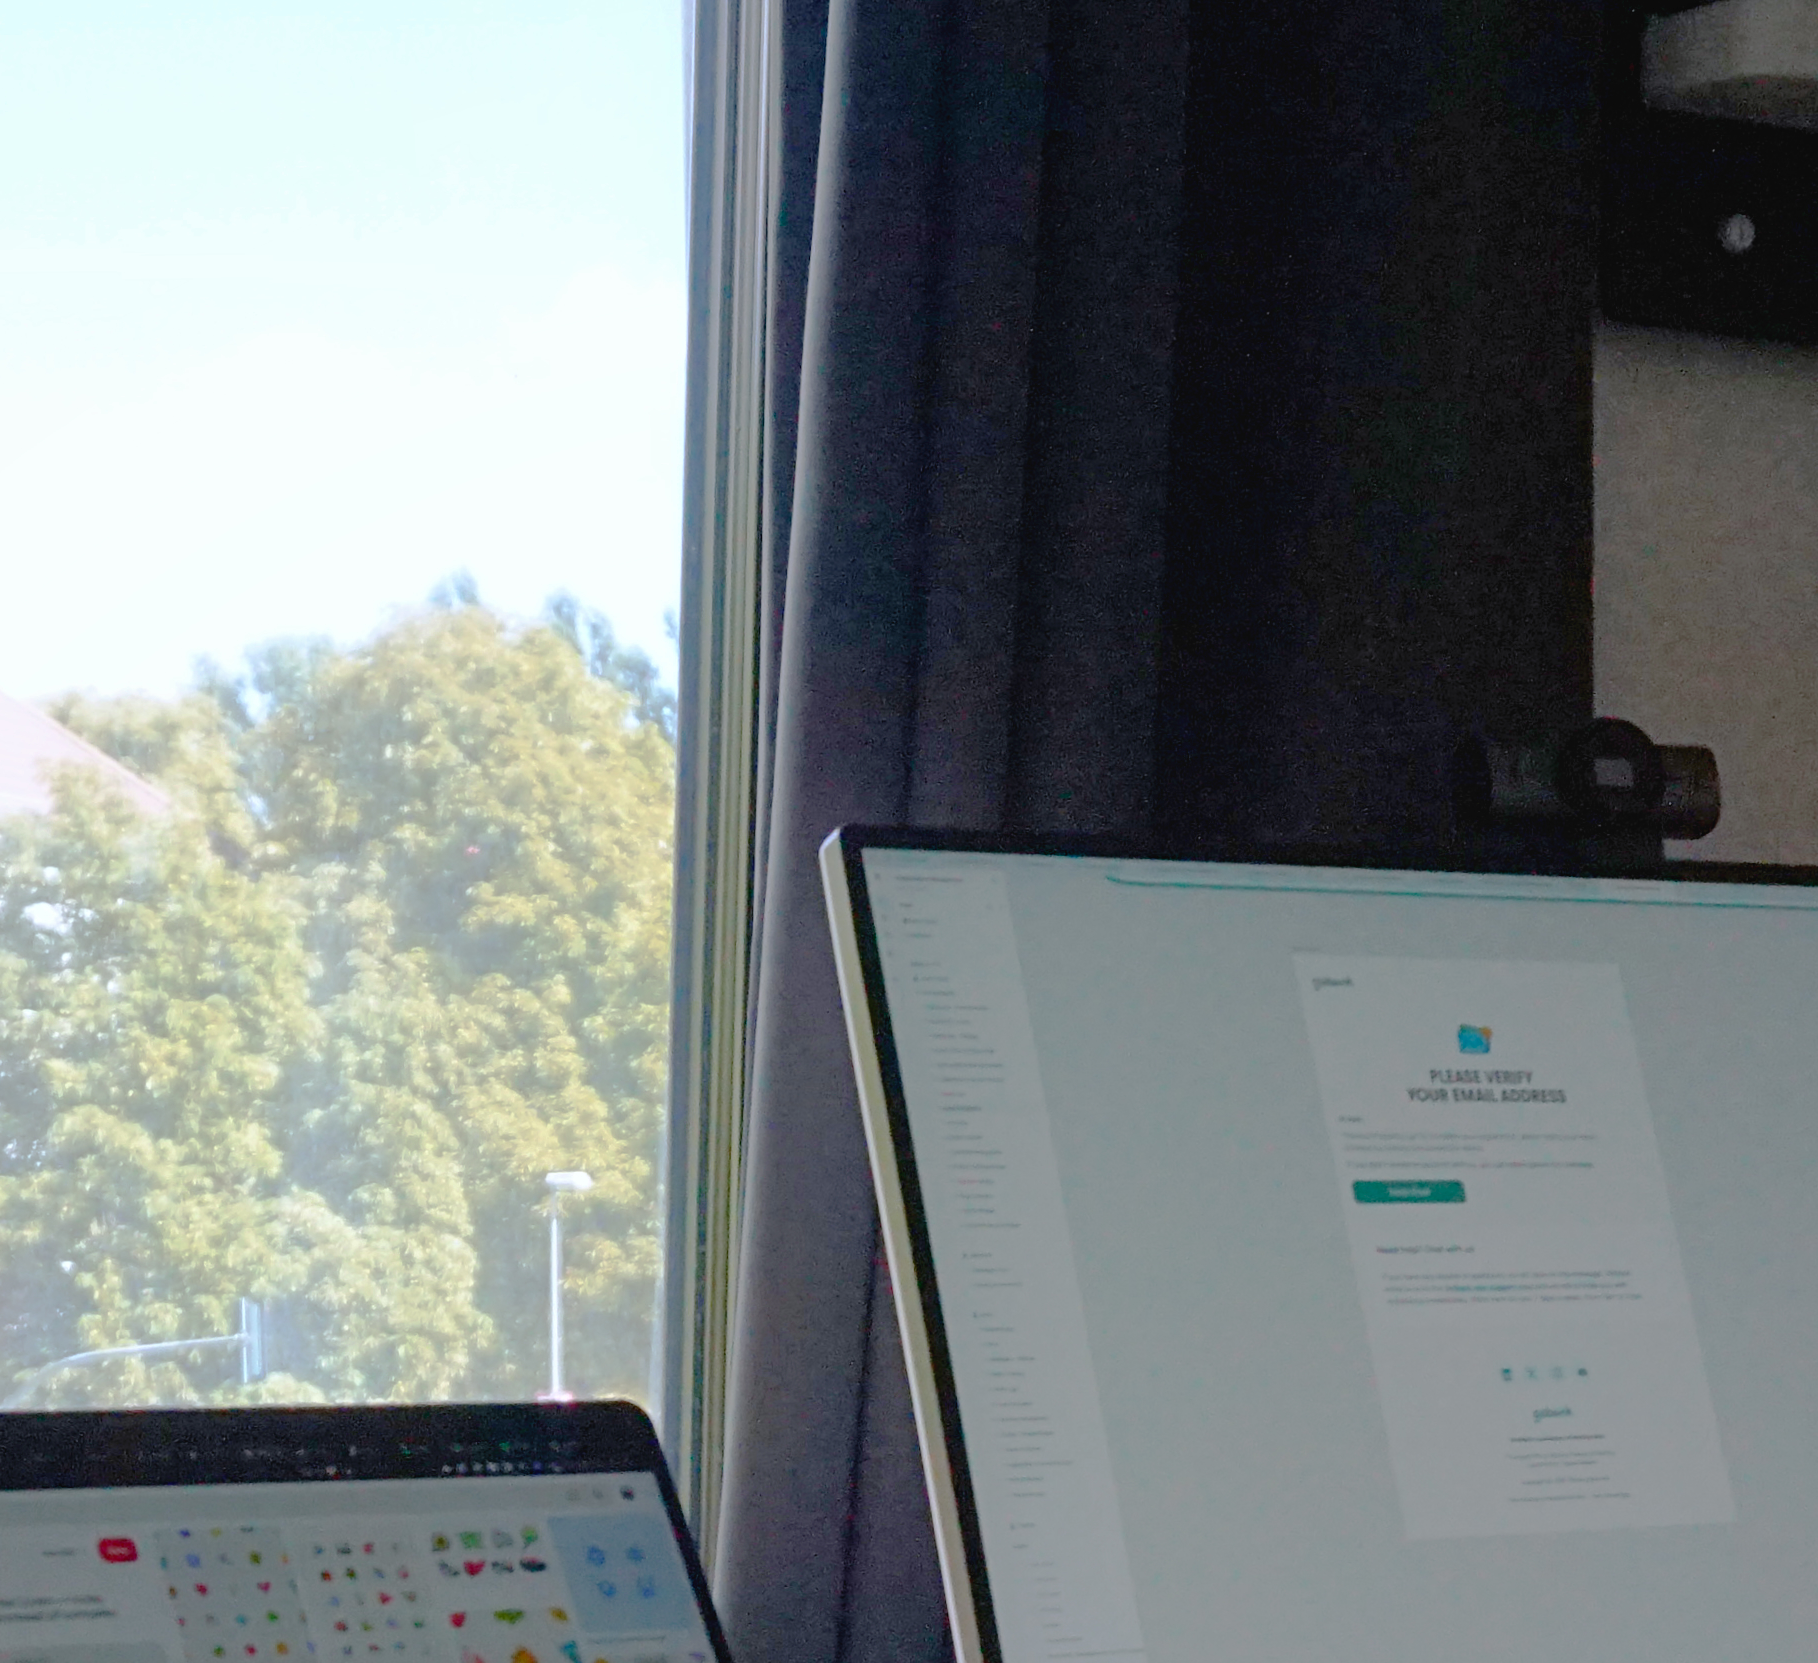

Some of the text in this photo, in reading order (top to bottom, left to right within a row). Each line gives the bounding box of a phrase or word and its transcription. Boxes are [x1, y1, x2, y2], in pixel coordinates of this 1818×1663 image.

[1429, 1068, 1533, 1085] PLEASE VERIFY
[1407, 1087, 1568, 1104] YOUR EMAIL ADDRESS
